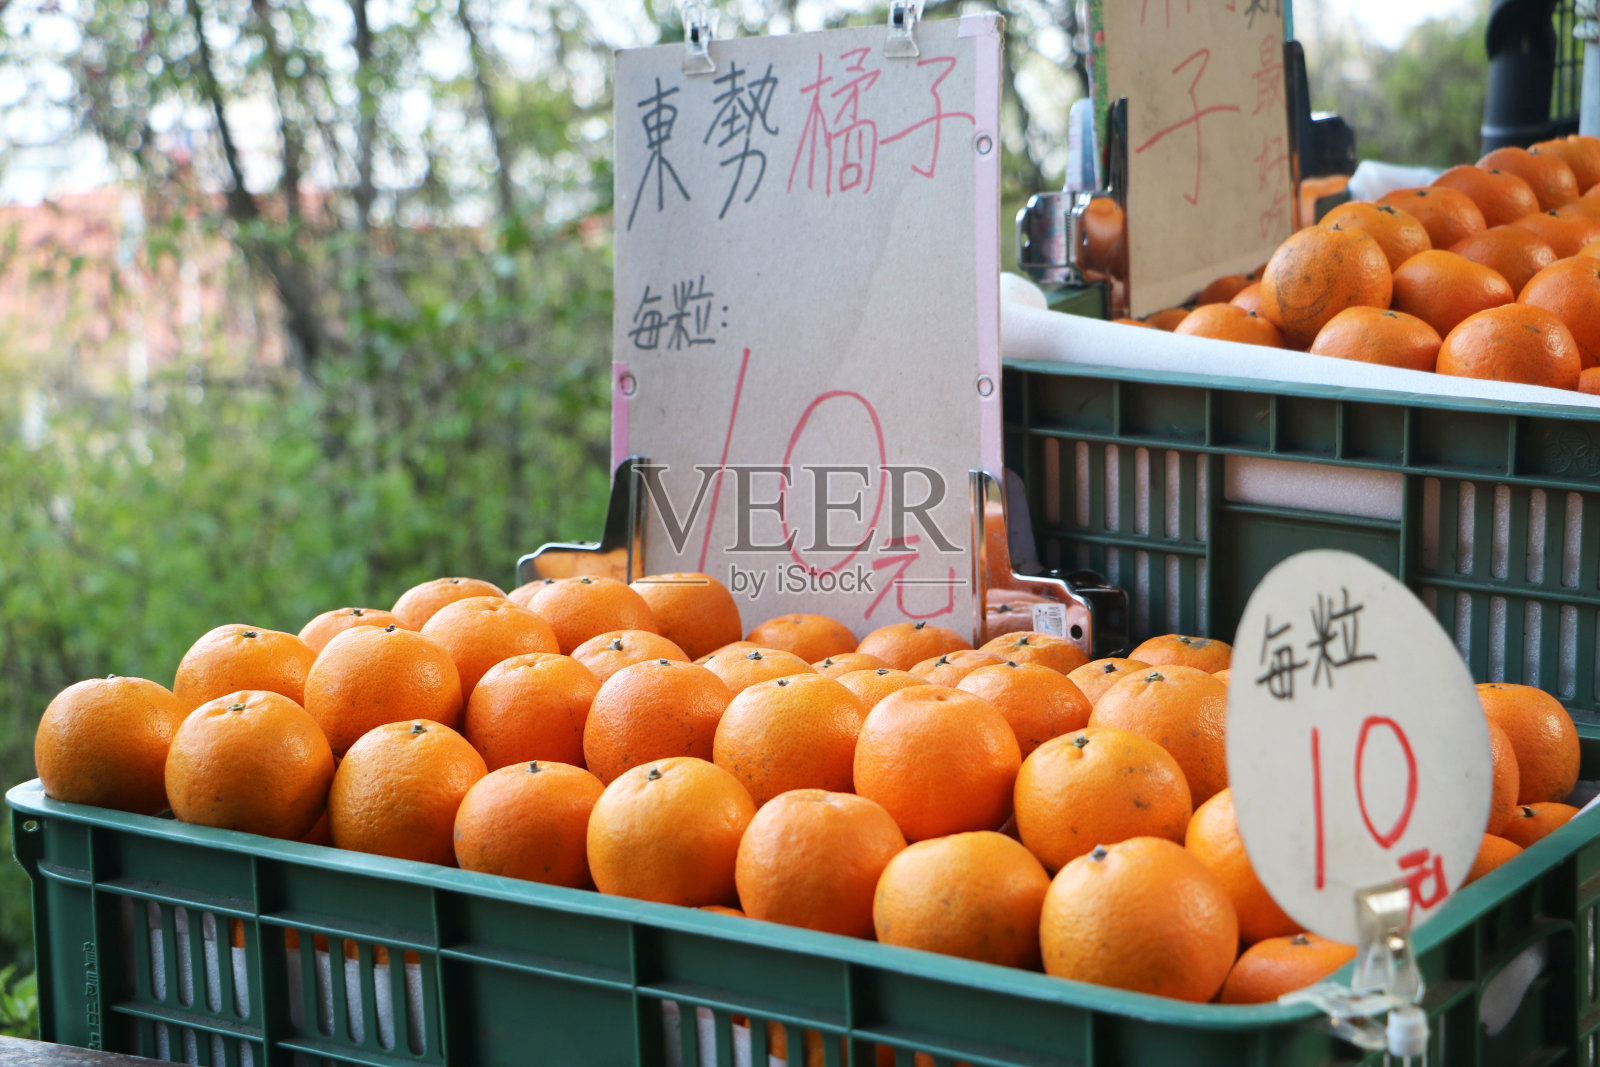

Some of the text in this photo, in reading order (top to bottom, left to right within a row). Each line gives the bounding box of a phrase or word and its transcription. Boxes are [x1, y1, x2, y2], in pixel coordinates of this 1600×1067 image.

[627, 47, 976, 232] 東勢橘子
[1255, 587, 1377, 701] 每粒
